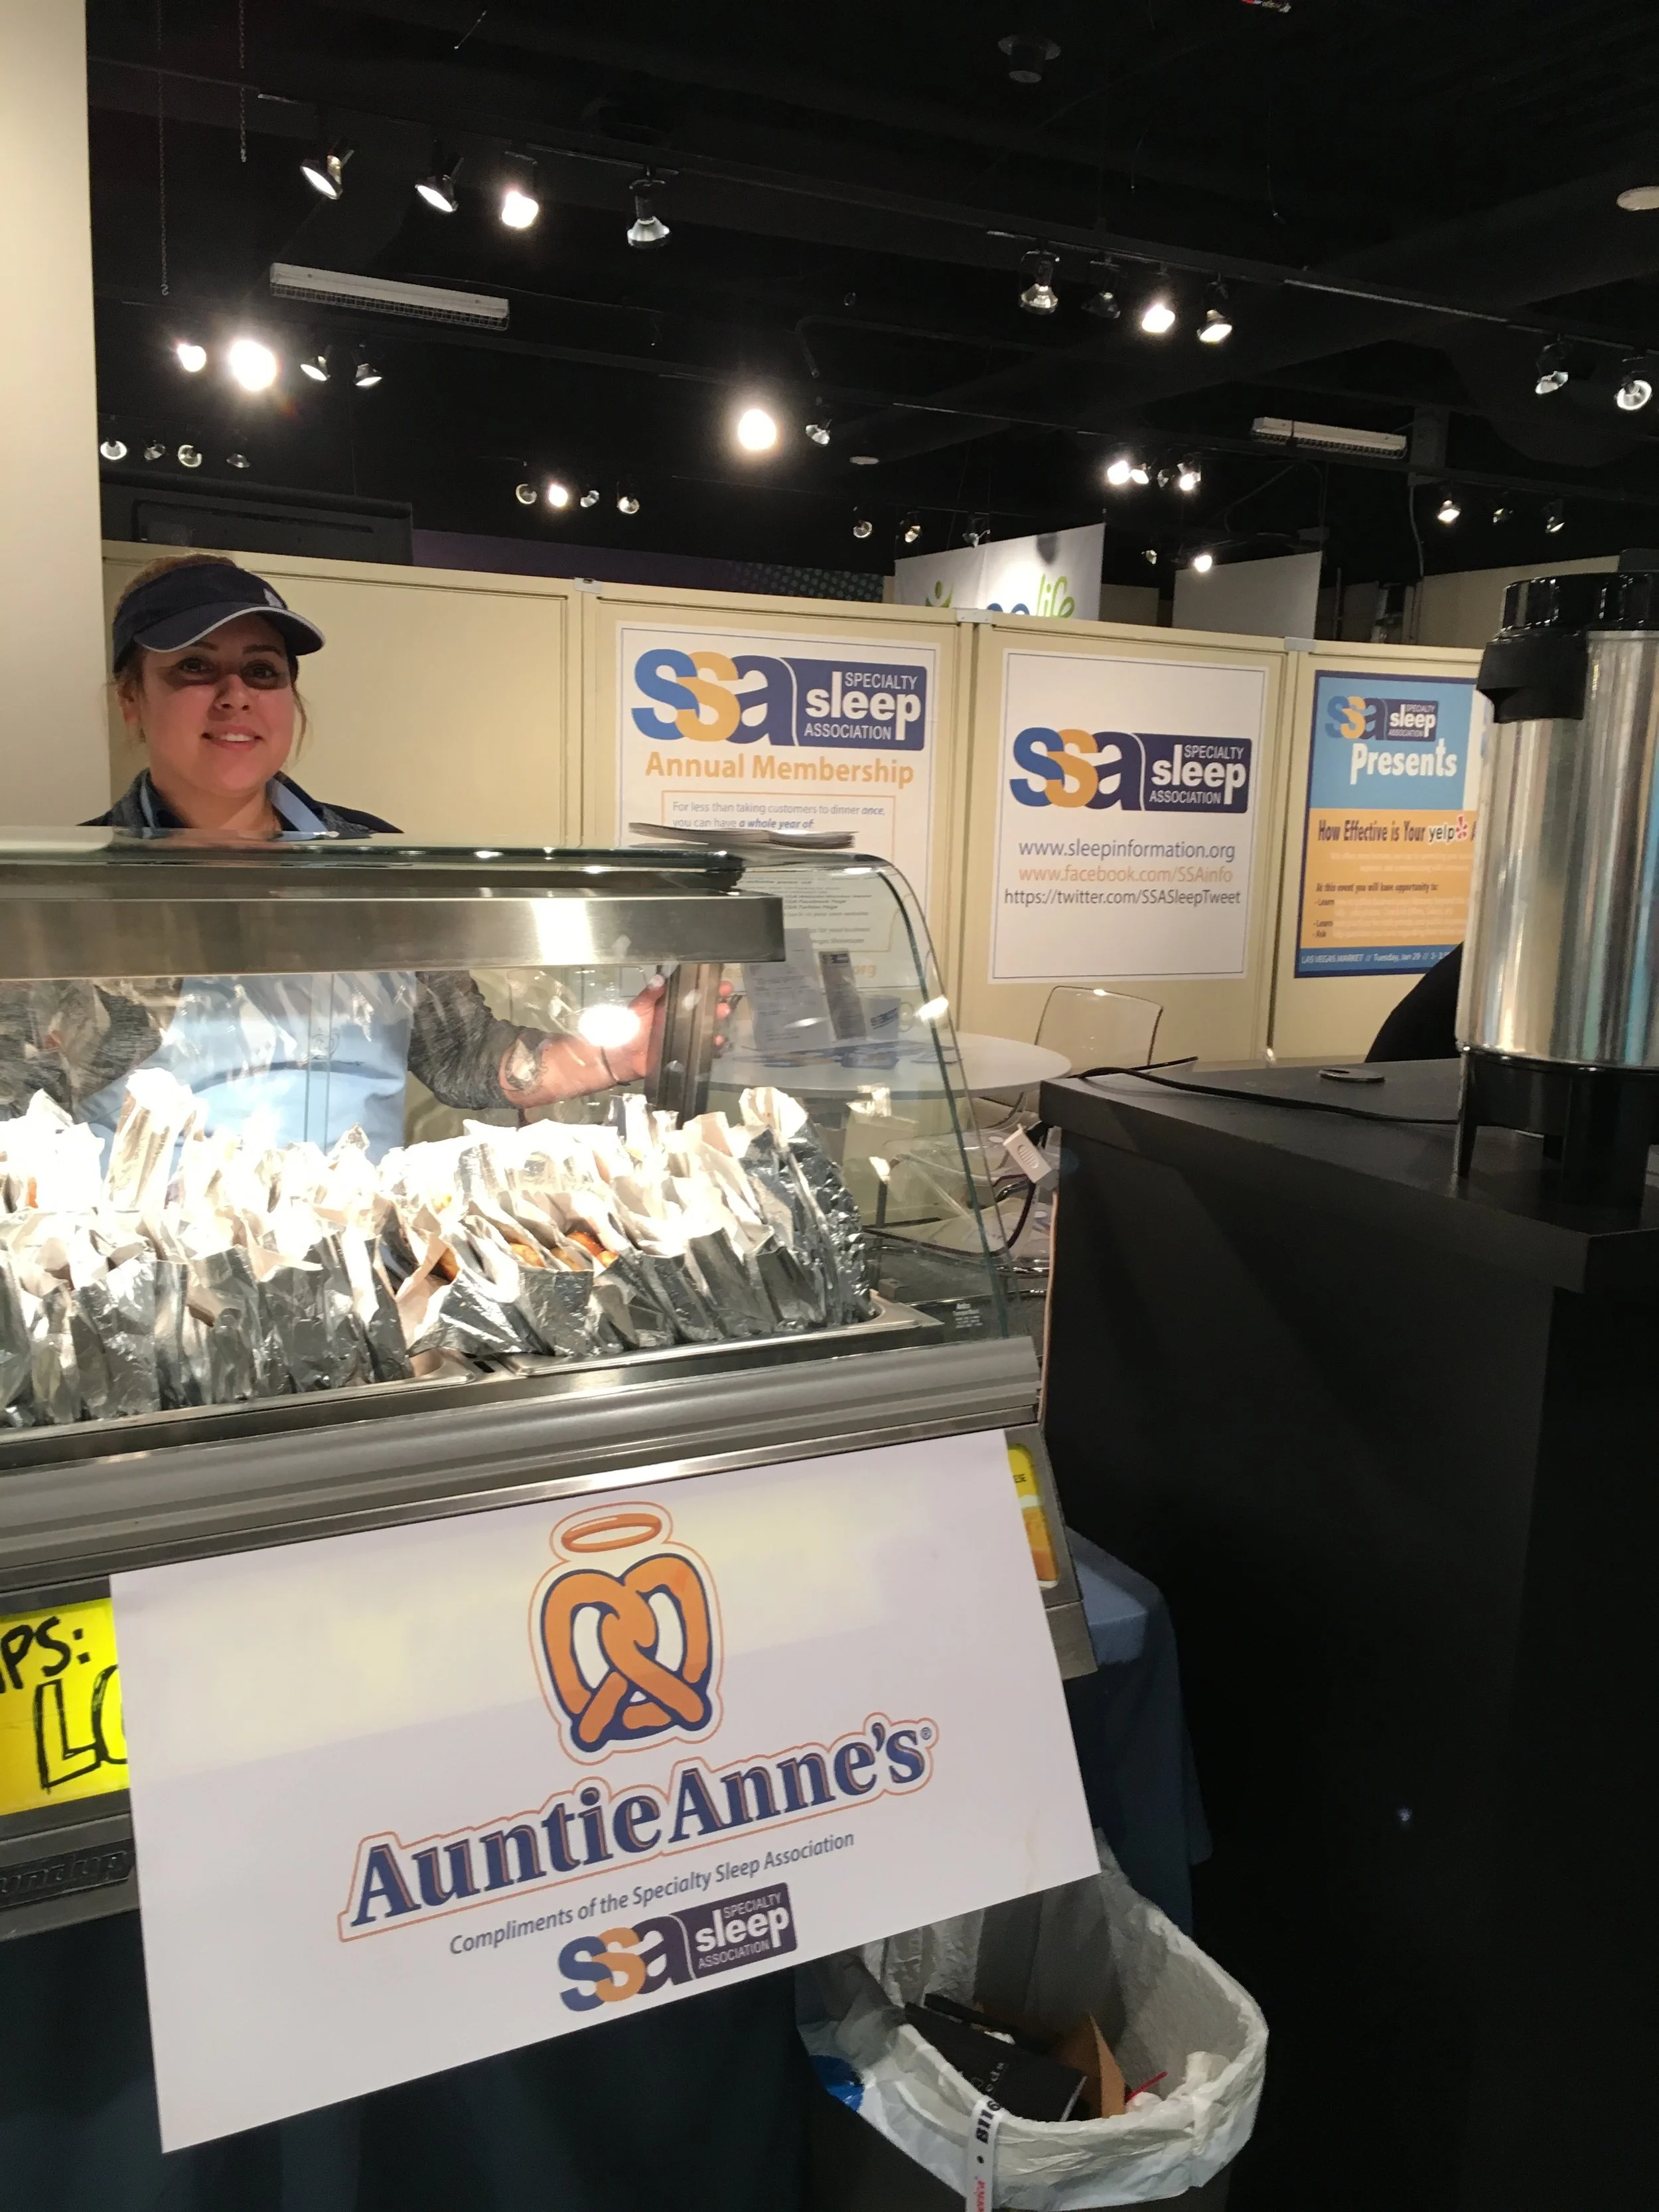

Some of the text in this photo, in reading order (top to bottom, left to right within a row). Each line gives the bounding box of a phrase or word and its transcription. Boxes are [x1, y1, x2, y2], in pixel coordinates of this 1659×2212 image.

[1036, 573, 1075, 618] life
[844, 672, 917, 690] SPECIALTY
[805, 671, 921, 741] sleep
[1406, 703, 1435, 713] SPECIALTY
[804, 723, 891, 740] ASSOCIATION
[1390, 703, 1436, 737] sleep
[1388, 729, 1424, 737] ASSOCIATION
[1184, 745, 1244, 760] SPECIALTY
[1350, 738, 1457, 784] Presents
[646, 752, 914, 788] Annual Membership
[1151, 745, 1246, 805] sleep
[673, 802, 688, 813] For
[691, 802, 709, 813] less
[712, 802, 735, 813] than
[736, 803, 766, 815] taking
[768, 804, 817, 814] customers
[819, 804, 829, 814] to
[830, 804, 859, 814] dinner
[1149, 790, 1221, 804] ASSOCIATION
[673, 820, 691, 829] you
[693, 819, 712, 828] can
[714, 818, 737, 828] have
[747, 818, 776, 828] whole
[778, 820, 800, 830] year
[1318, 820, 1340, 841] How
[1343, 820, 1388, 841] Effective
[1390, 821, 1400, 841] is
[1404, 820, 1425, 842] Your
[1428, 824, 1455, 843] yelp
[1019, 838, 1236, 862] www.sleepinformation.org
[1019, 864, 1233, 883] www.facebook.com/SSAinfo
[1004, 888, 1240, 907] https://twitter.com/SSASleepTweet
[350, 1787, 662, 1927] Auntie
[450, 1834, 854, 1955] Compliments of the Specialty Sleep Association
[723, 1892, 781, 1918] SPECIALTY
[695, 1906, 790, 1952] sleep
[698, 1939, 770, 1969] ASSOCIATION
